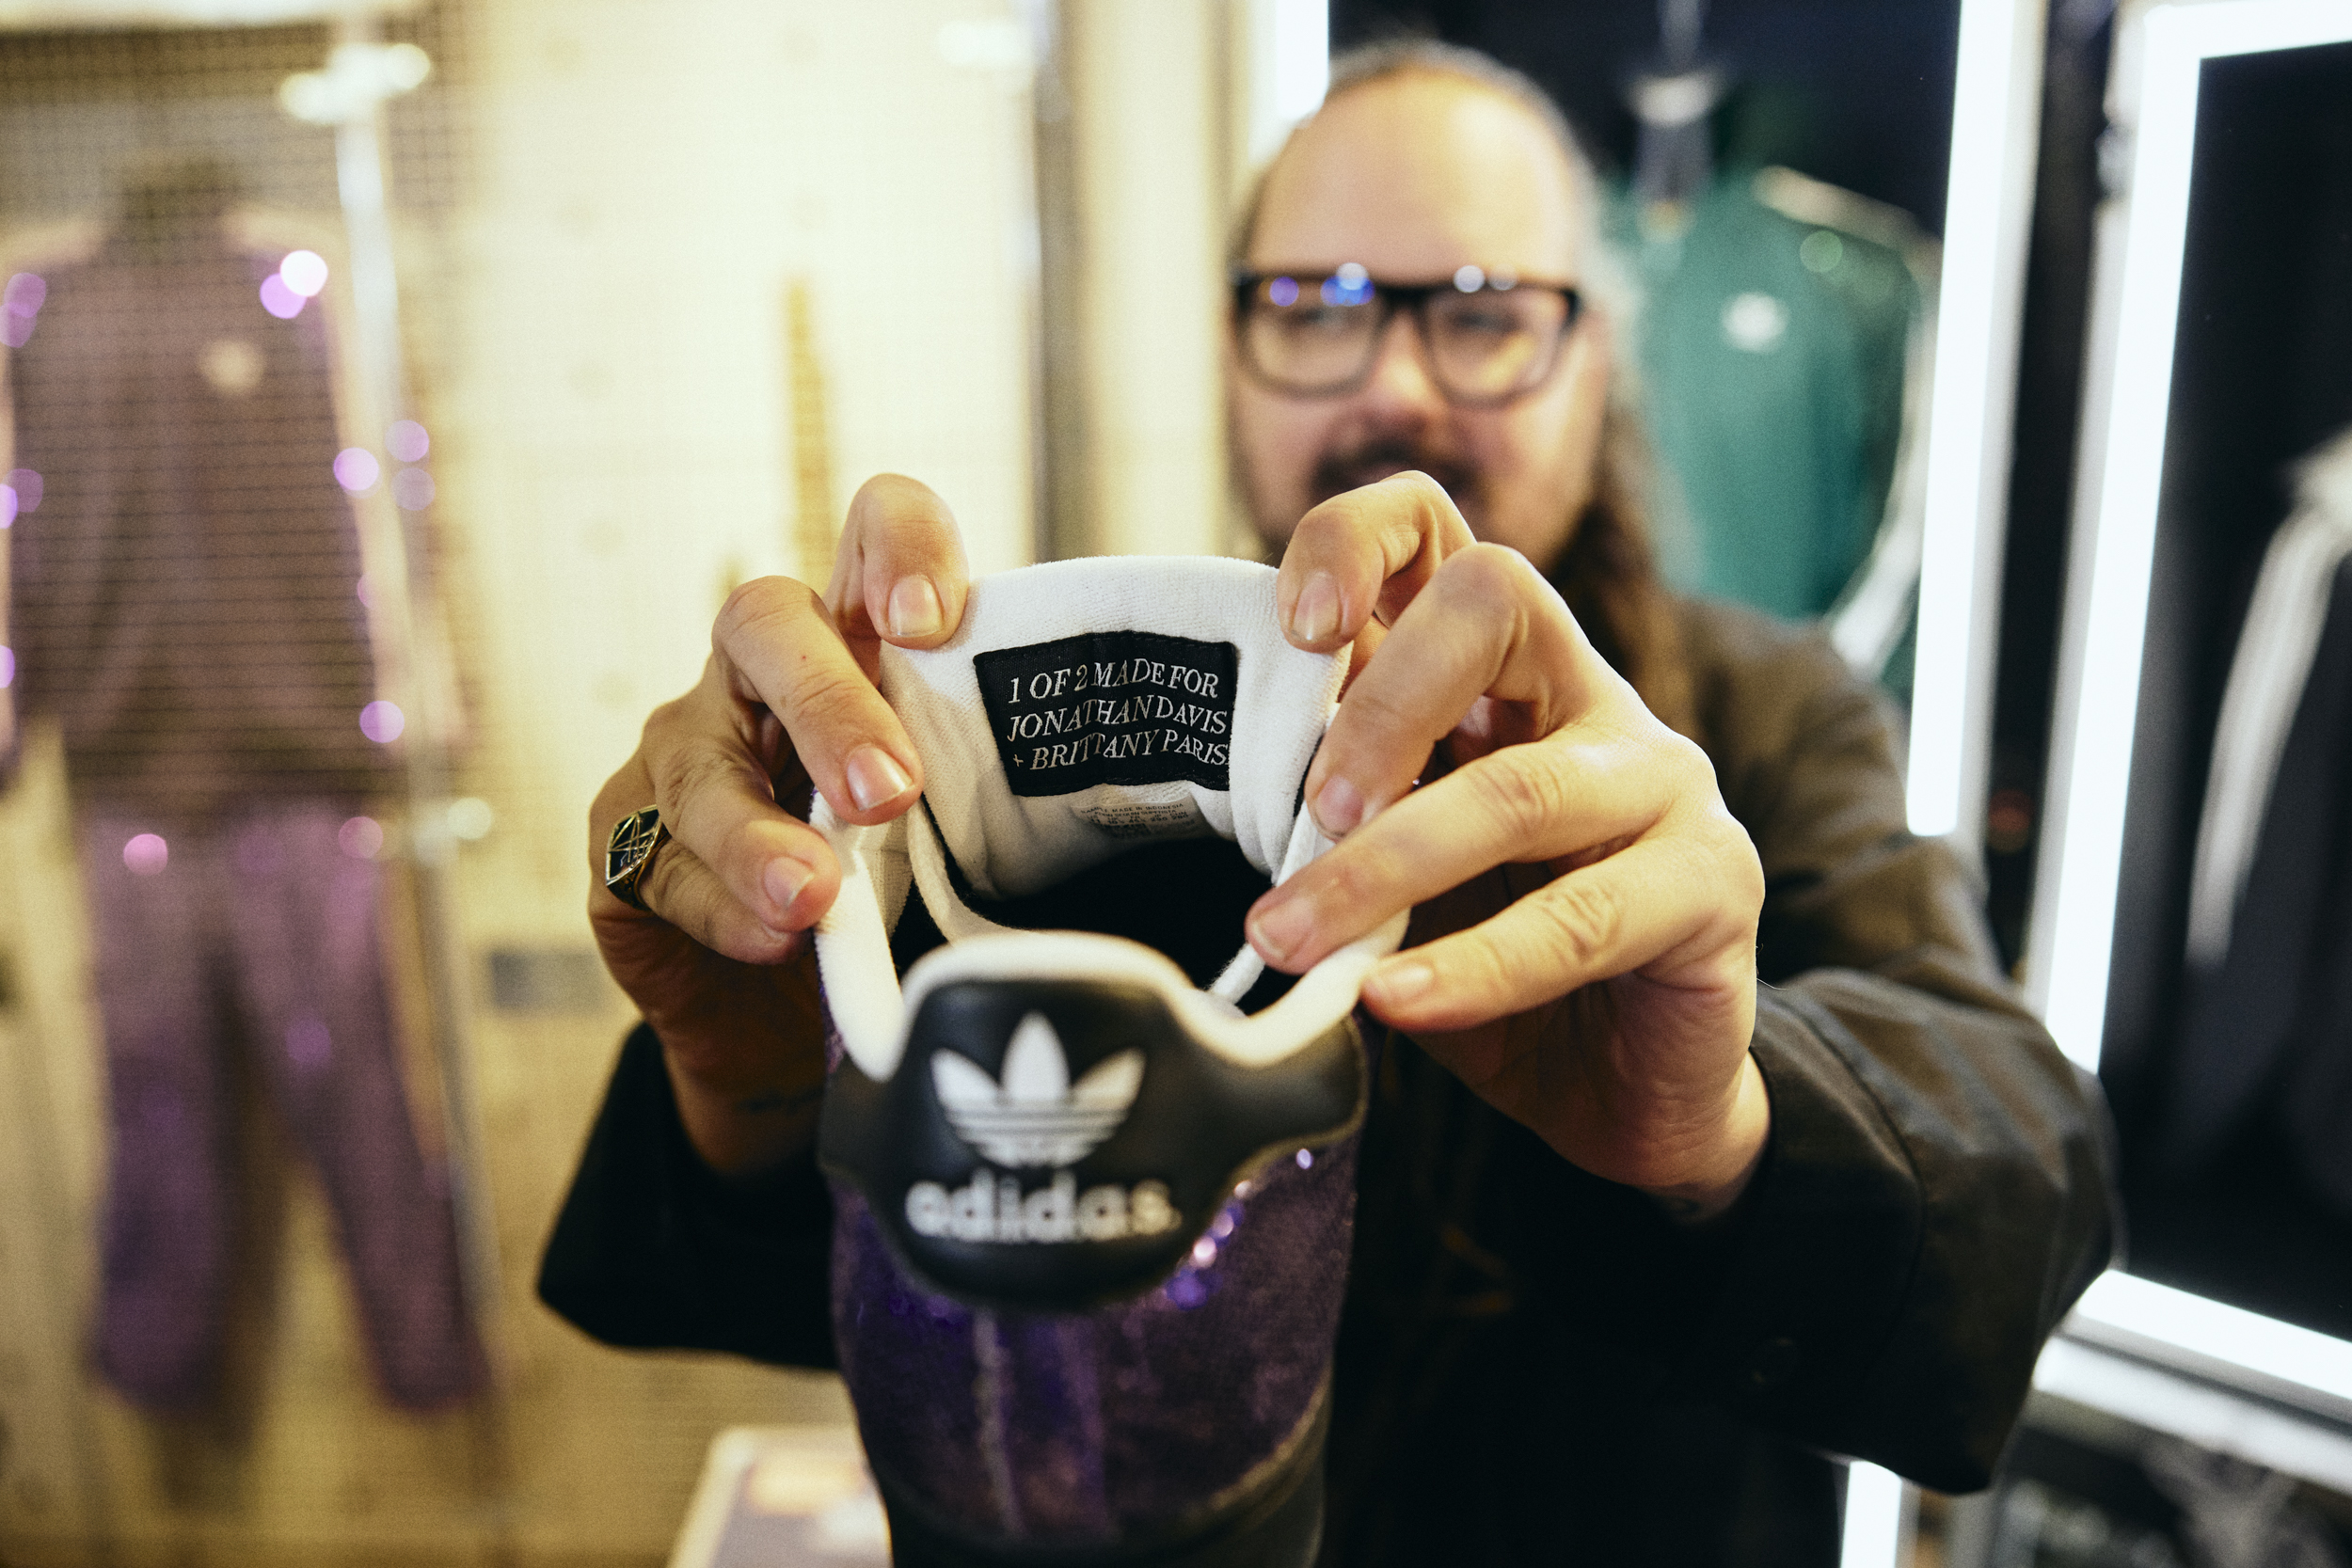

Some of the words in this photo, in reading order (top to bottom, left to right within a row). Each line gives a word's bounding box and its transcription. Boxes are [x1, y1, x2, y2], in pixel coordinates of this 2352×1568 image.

[1008, 677, 1021, 704] 1
[1029, 668, 1071, 699] OF
[1073, 664, 1089, 691] 2
[1091, 657, 1166, 688] MADE
[1168, 664, 1219, 698] FOR
[1007, 694, 1154, 742] JONATHAN
[1154, 695, 1228, 735] DAVIS
[1029, 729, 1160, 770] BRITTANY
[1160, 729, 1230, 766] PARIS
[905, 1168, 1176, 1244] adidas
